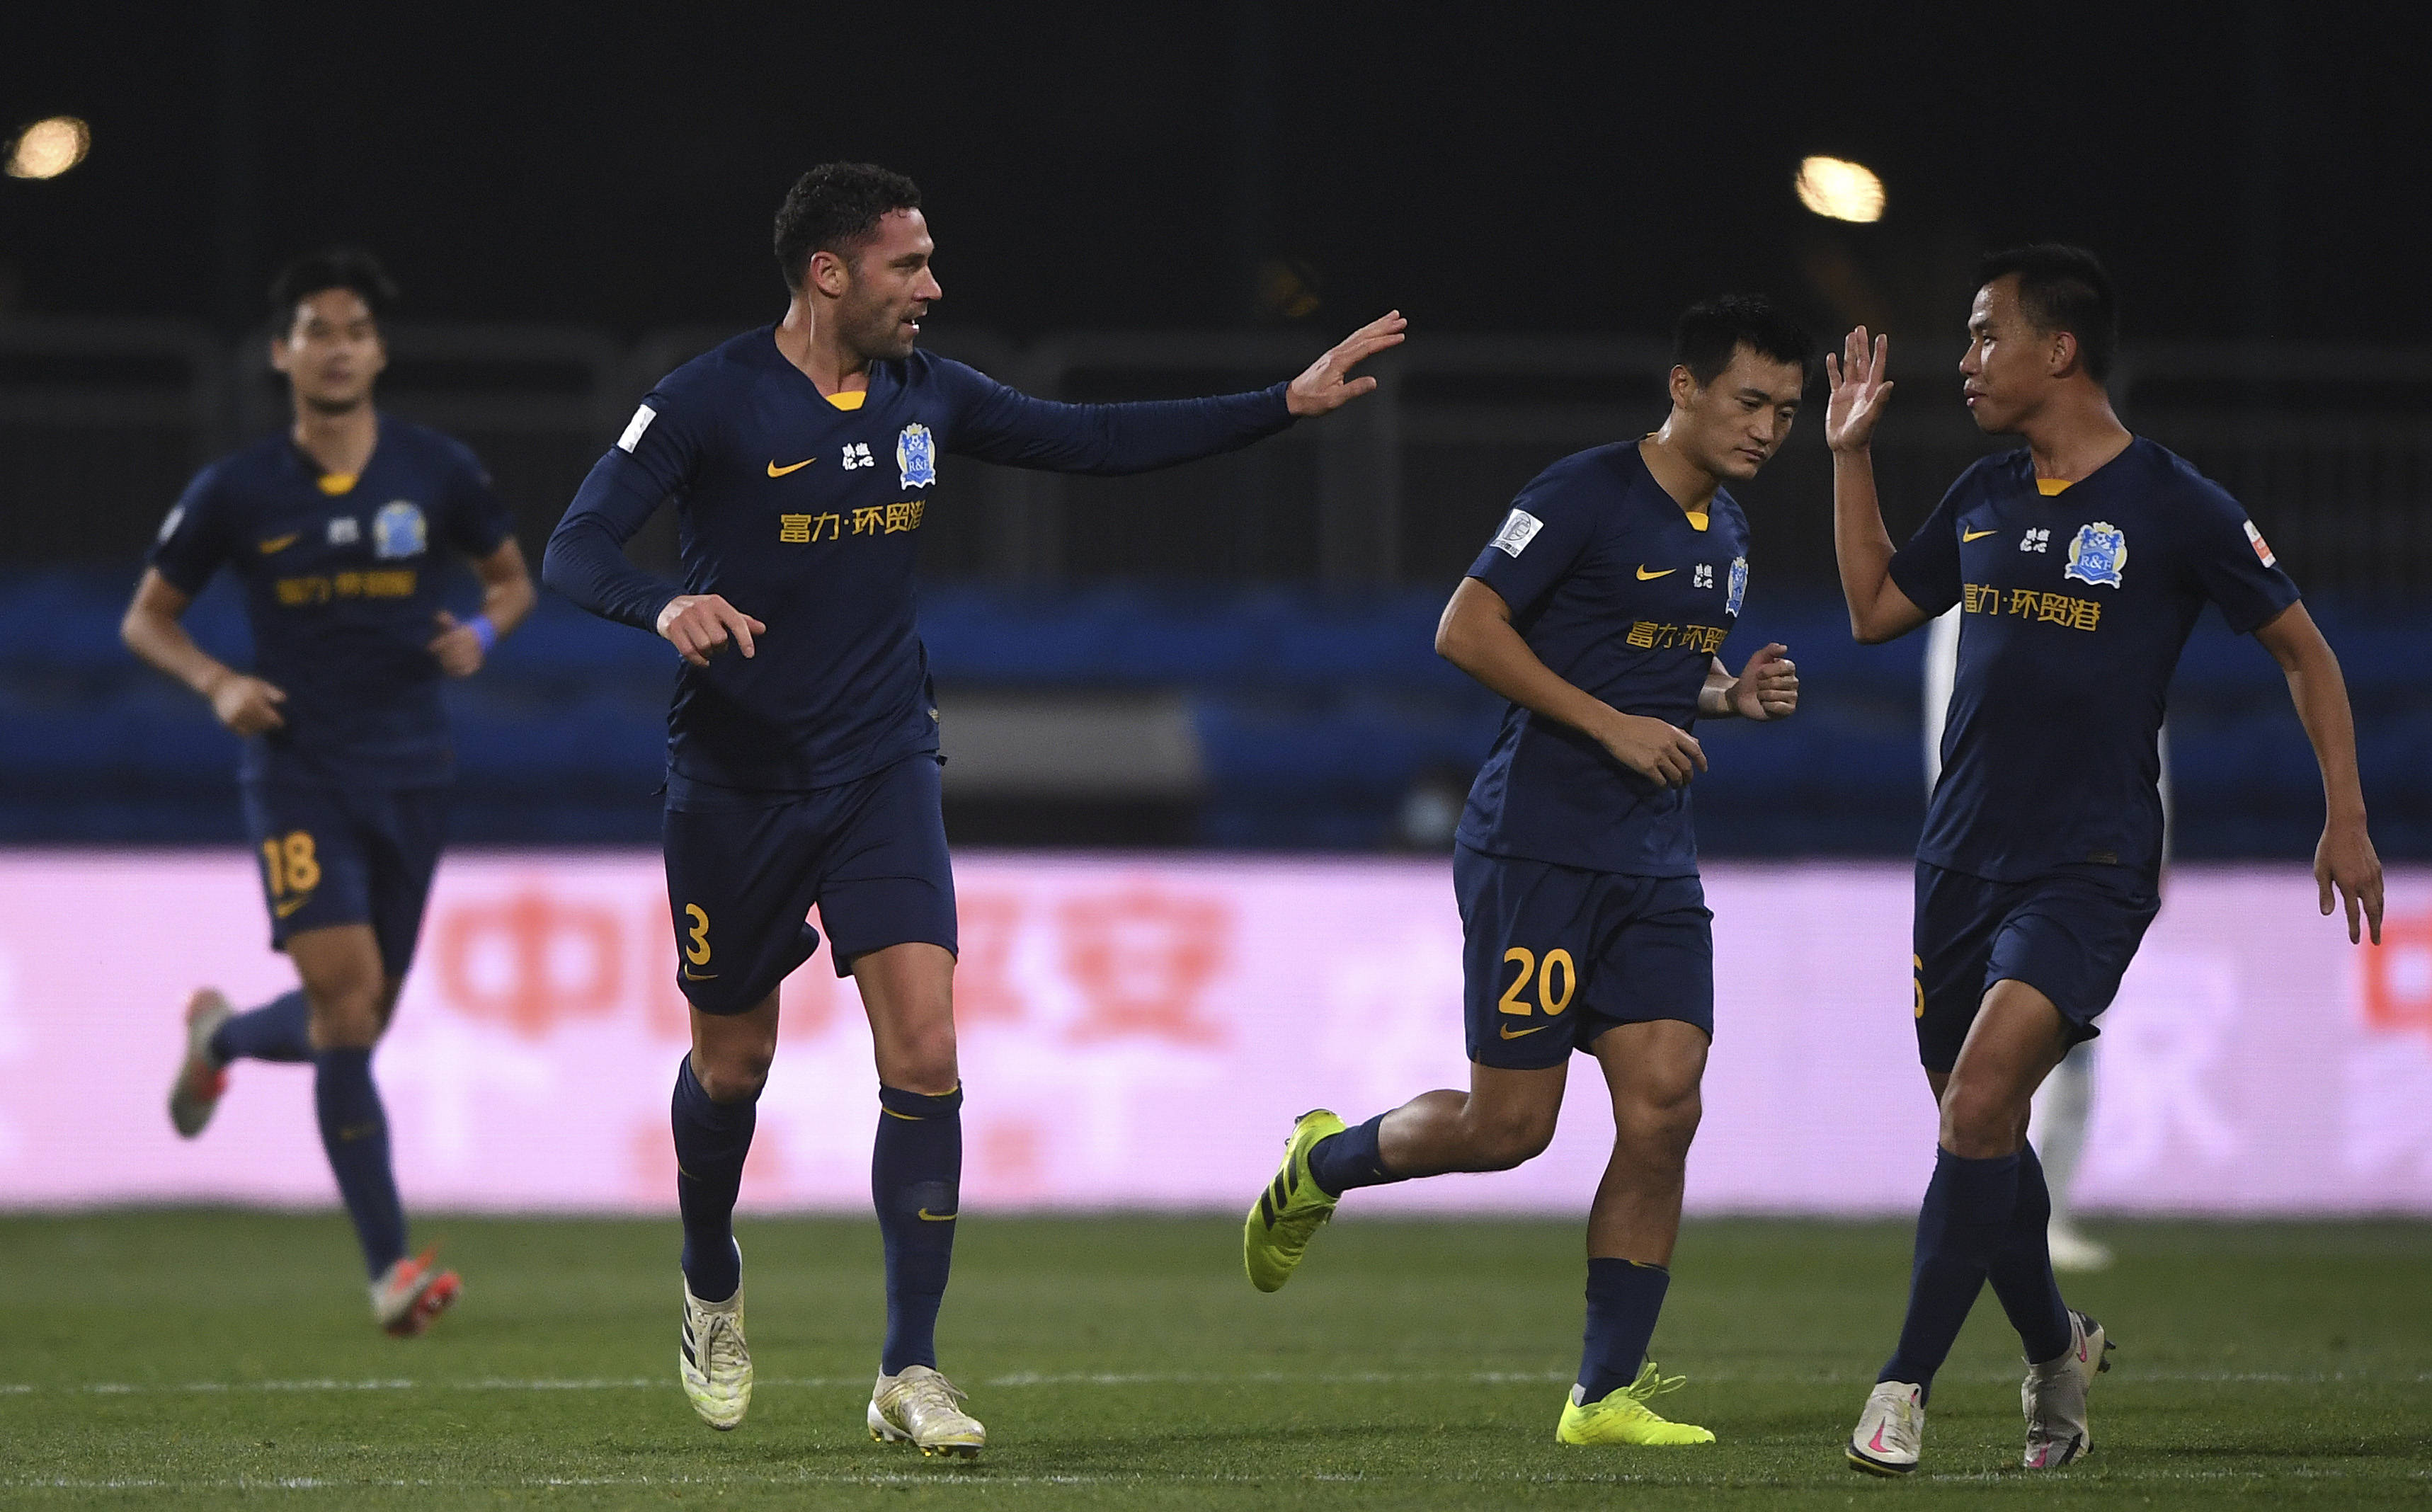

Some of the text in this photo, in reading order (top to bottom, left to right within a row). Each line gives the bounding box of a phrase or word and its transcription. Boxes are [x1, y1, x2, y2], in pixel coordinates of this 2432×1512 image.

[2079, 554, 2113, 571] R&F
[1963, 583, 2101, 632] 富力·环贸港
[1626, 621, 1728, 655] 富力·环贸
[263, 830, 321, 897] 18
[686, 903, 712, 966] 3
[1498, 947, 1577, 1016] 20
